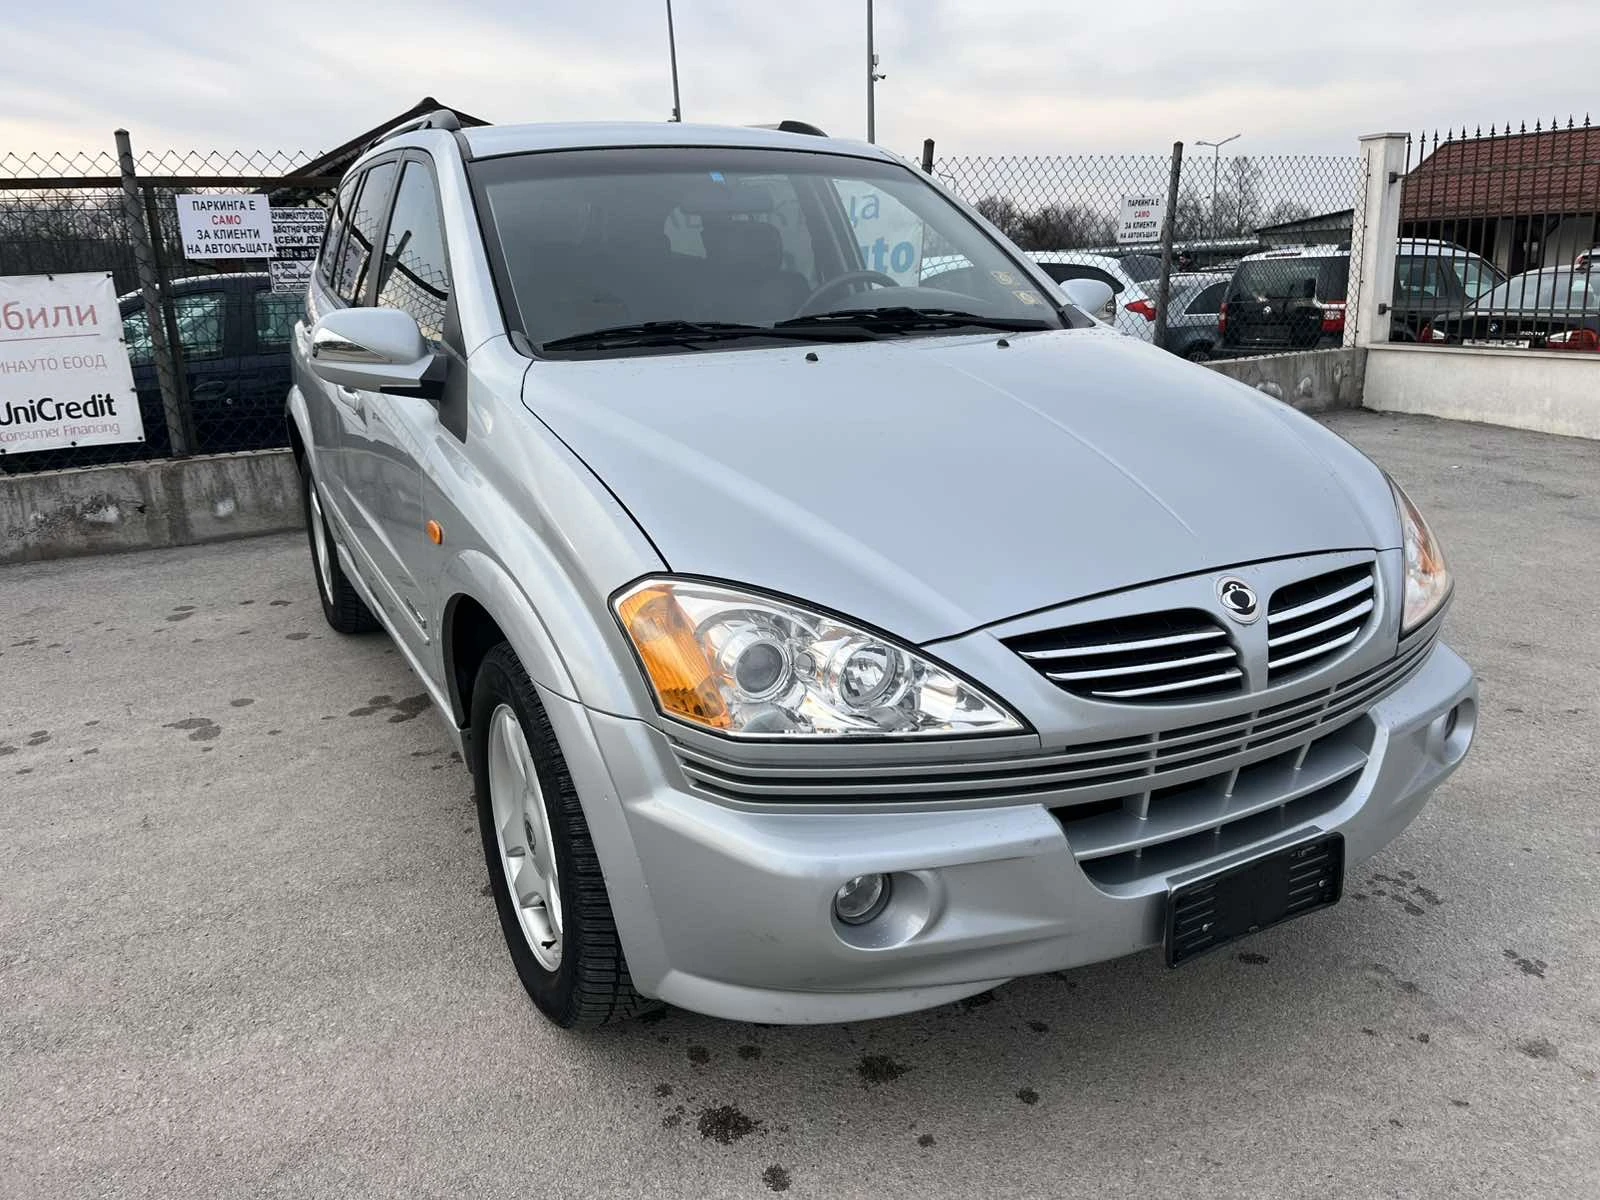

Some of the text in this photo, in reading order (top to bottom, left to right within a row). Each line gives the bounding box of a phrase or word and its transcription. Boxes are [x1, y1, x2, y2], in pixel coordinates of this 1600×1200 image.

[192, 200, 256, 211] ПАРКИНГА Е
[211, 214, 242, 225] САМО
[1134, 210, 1151, 218] САМО
[196, 228, 260, 240] ЗА КЛИЕНТИ
[272, 225, 301, 234] АБОТНО
[186, 244, 200, 254] НА
[204, 242, 275, 254] АВТОКЪЩАТА
[0, 301, 98, 330] били
[63, 354, 108, 370] ЕООД
[0, 422, 120, 443] Consumer Financing
